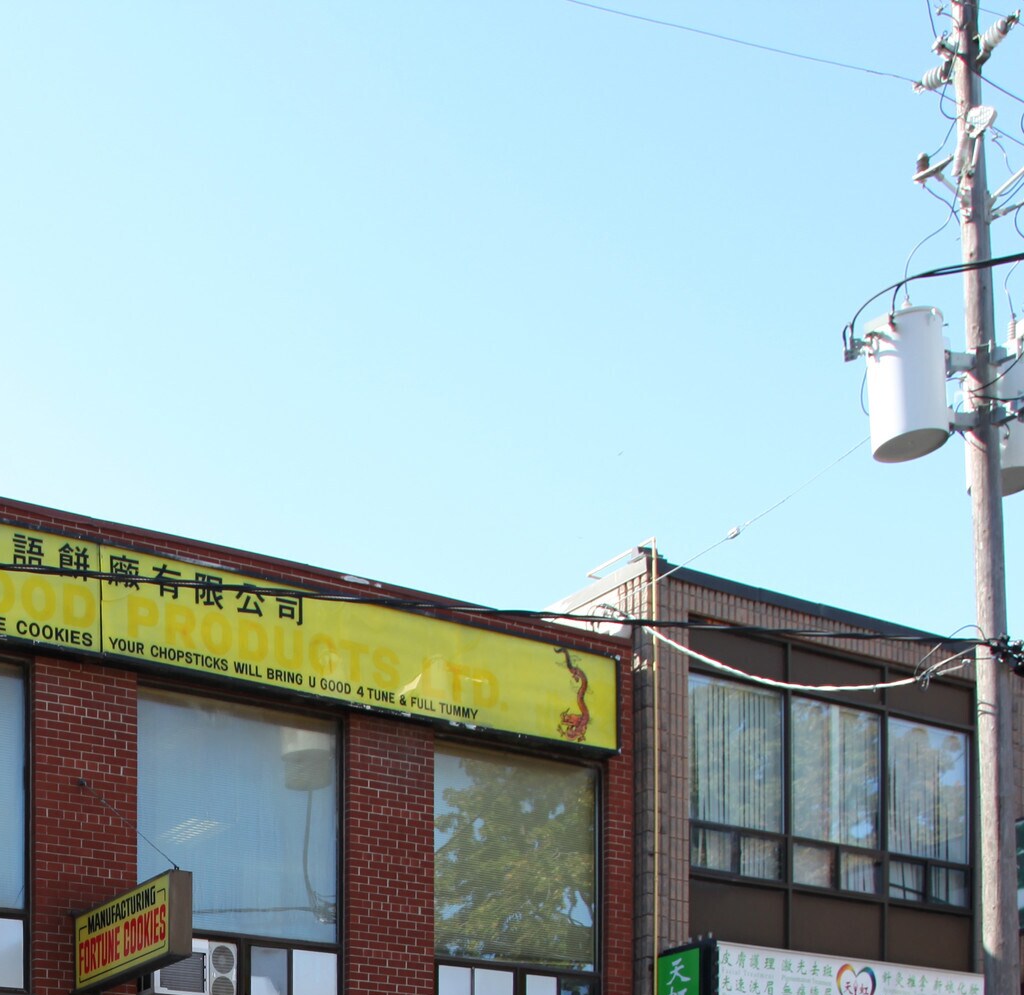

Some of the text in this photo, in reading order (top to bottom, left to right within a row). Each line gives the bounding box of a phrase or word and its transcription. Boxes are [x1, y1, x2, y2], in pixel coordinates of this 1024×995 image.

[15, 619, 93, 647] COOKIES
[127, 594, 400, 689] PRODUCTS
[108, 636, 479, 720] YOUR CHOPSTICKS WILL BRING U GOOD 4 TUNE & FULL TUMMY
[79, 904, 166, 977] FORTUNE COOKIES
[87, 885, 156, 935] MANUFACTURING
